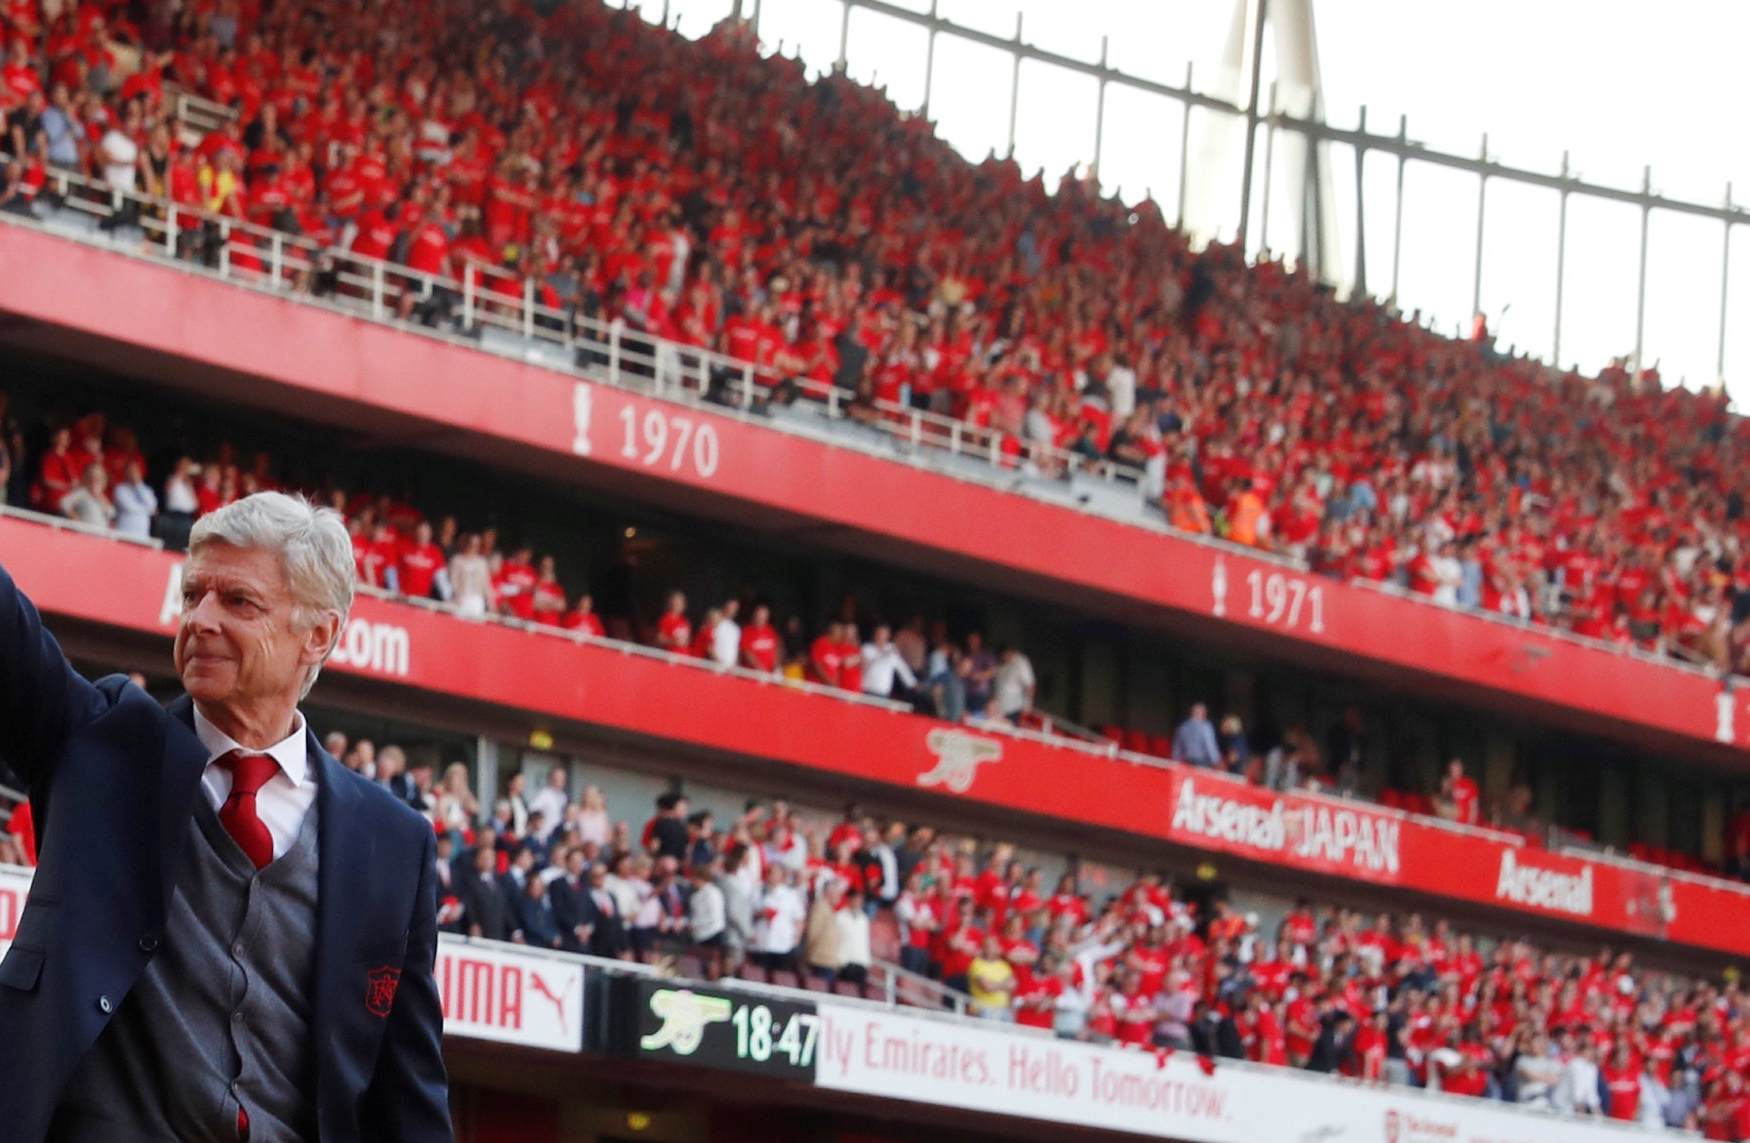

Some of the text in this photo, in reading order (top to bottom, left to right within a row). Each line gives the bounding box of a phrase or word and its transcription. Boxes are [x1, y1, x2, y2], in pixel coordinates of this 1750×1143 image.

[619, 404, 719, 478] 1970
[1247, 569, 1325, 634] 1971
[1172, 778, 1400, 874] Arsenal JAPAN
[434, 955, 523, 1030] UMA
[732, 1003, 821, 1068] 18:47
[1007, 1044, 1081, 1098] Hello
